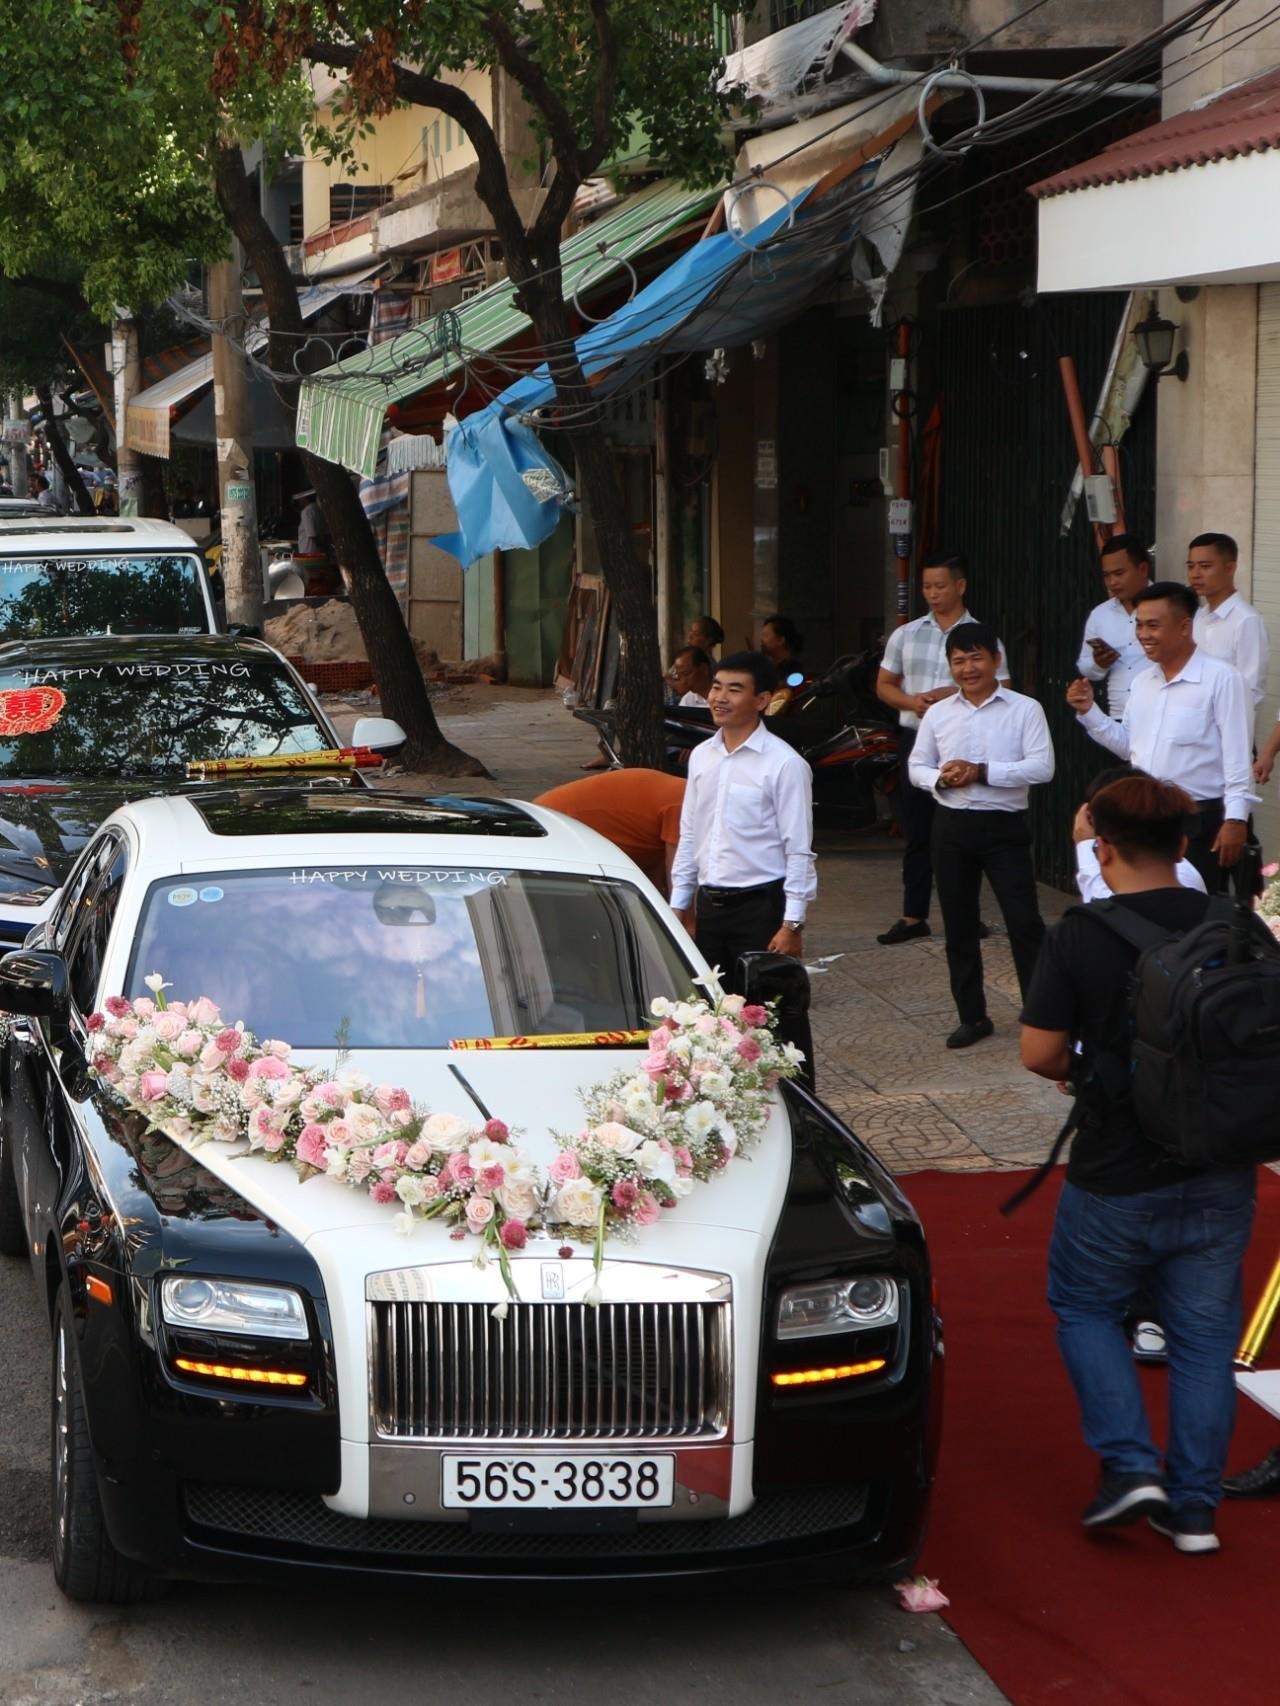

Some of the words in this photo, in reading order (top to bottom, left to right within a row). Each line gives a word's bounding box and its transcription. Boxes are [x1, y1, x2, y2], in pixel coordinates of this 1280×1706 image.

[2, 560, 50, 574] HAPPY
[56, 557, 129, 572] WEDDING
[20, 666, 103, 685] HAPPY
[116, 663, 250, 680] WEDDING
[288, 868, 368, 885] HAPPY
[377, 870, 508, 887] WEDDING
[456, 1460, 660, 1502] 56S-3838
